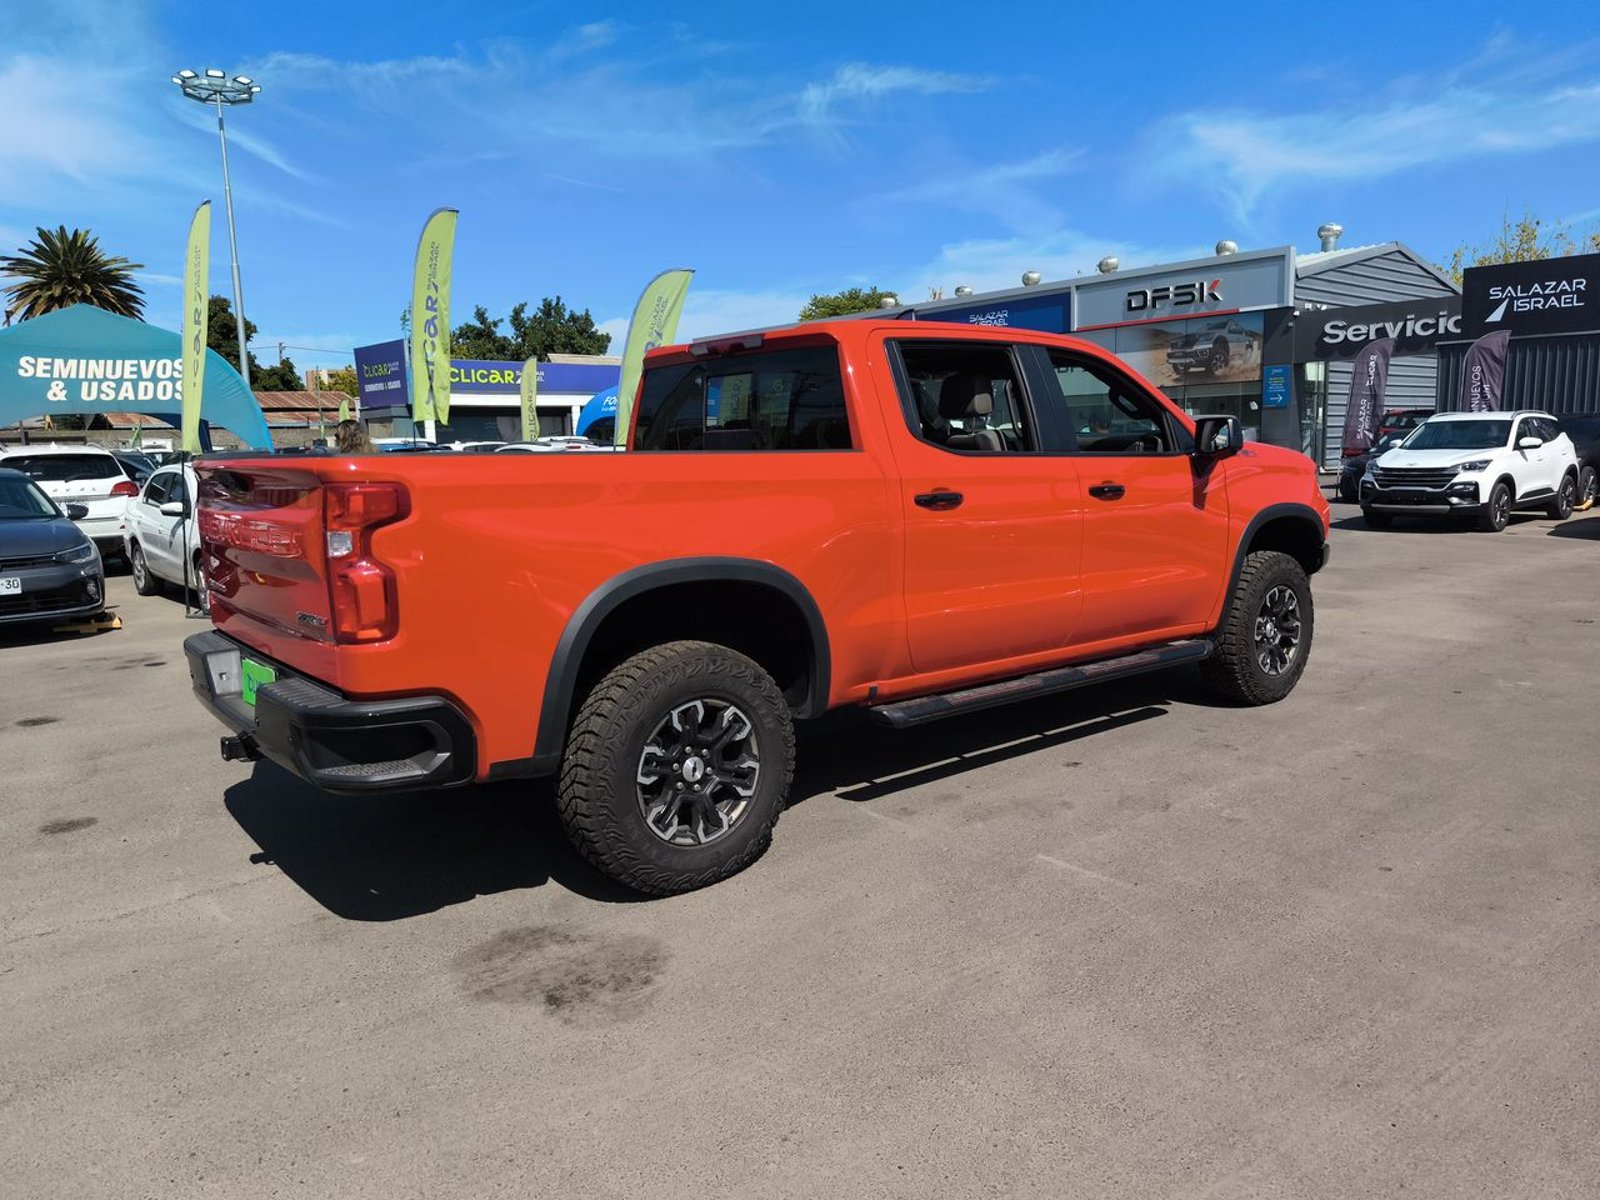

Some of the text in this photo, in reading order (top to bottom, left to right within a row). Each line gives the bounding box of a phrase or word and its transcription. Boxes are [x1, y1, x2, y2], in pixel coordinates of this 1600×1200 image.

[1127, 279, 1223, 311] DFSK
[1489, 278, 1586, 299] SALAZAR
[1513, 294, 1585, 312] ISRAEL
[969, 310, 1008, 323] SALAZAR
[18, 355, 183, 380] SEMINUEVOS
[46, 381, 183, 401] & USADOS
